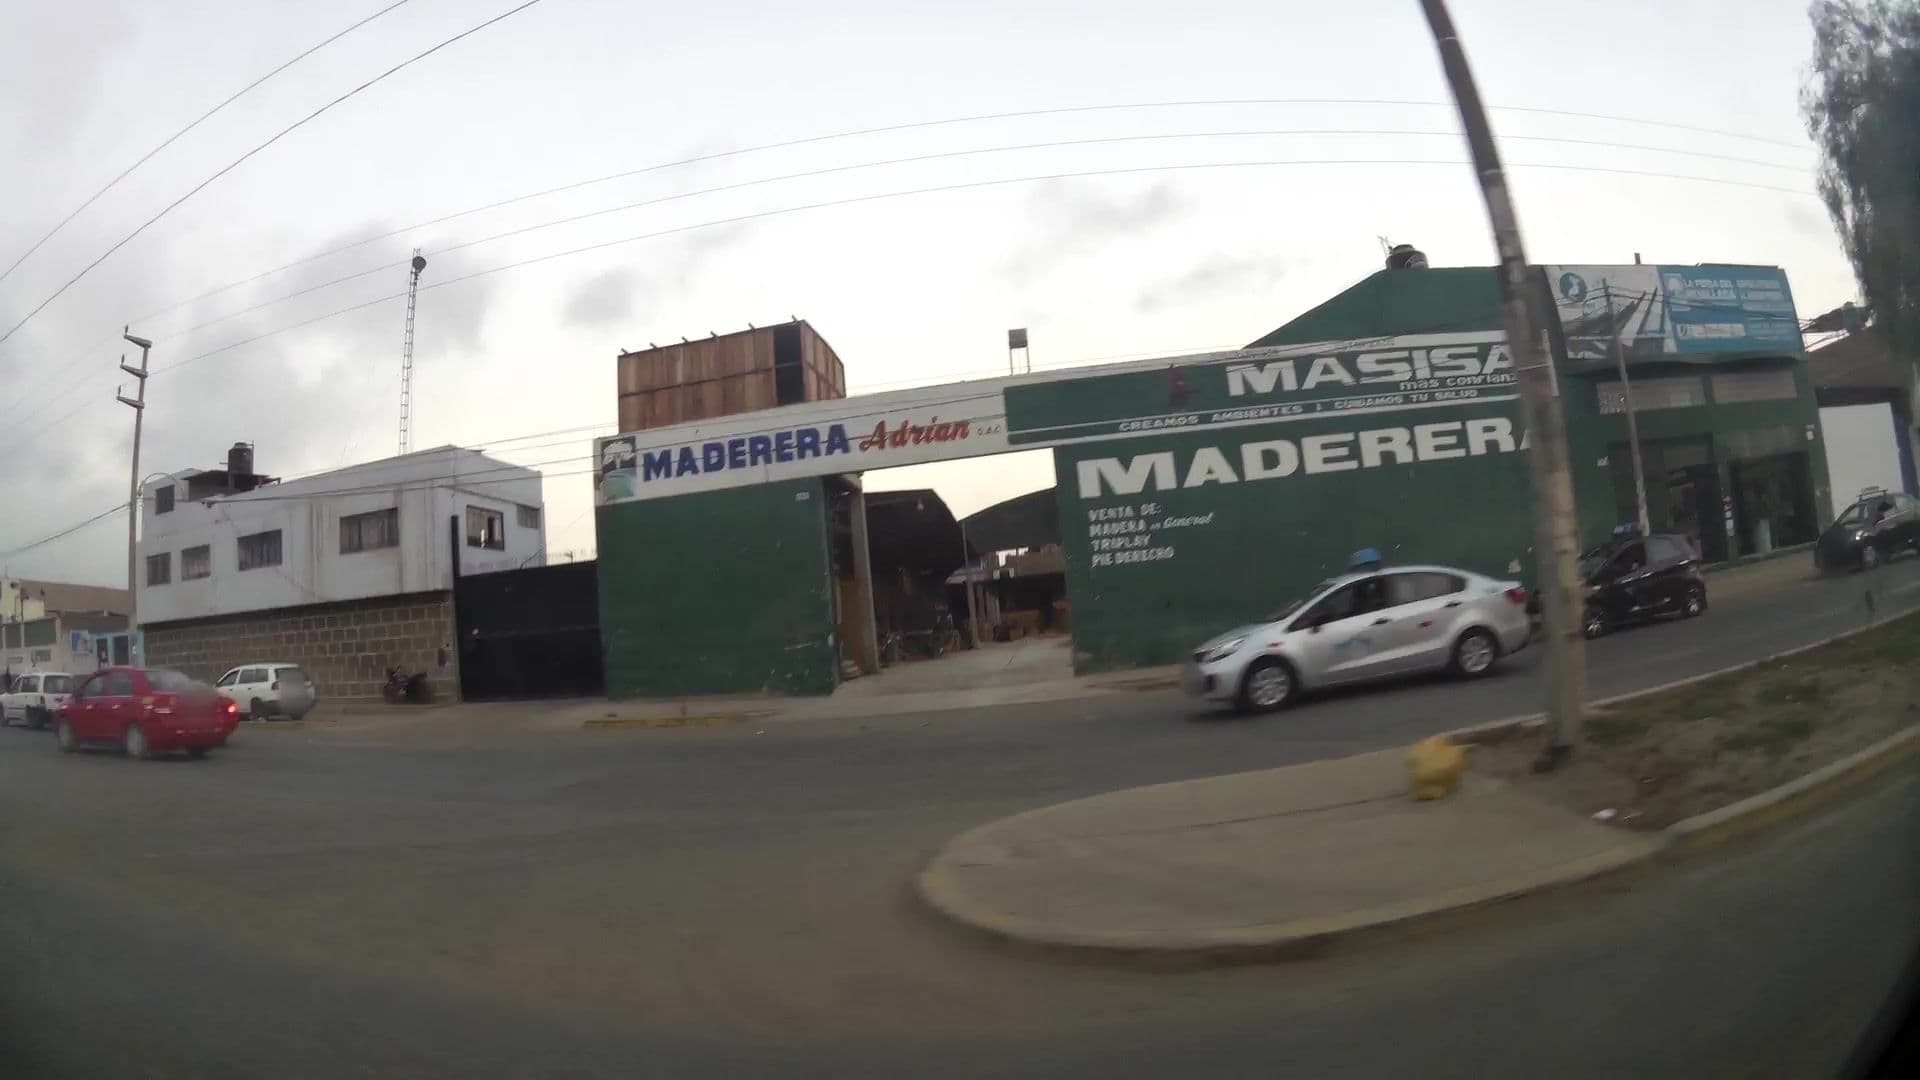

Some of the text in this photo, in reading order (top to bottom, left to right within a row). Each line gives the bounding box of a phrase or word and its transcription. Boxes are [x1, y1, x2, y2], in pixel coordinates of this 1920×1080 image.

[1225, 345, 1516, 396] MASISA
[1118, 415, 1200, 431] CREAMOS
[1210, 405, 1304, 422] AMBIENTES
[1333, 394, 1404, 410] CUDAMOS
[1409, 393, 1429, 402] TU
[1434, 389, 1478, 400] SALUD
[643, 424, 850, 482] MADERERA
[858, 416, 971, 452] Adrian
[1077, 417, 1532, 499] MADERER
[1088, 505, 1134, 522] VENTA
[1089, 519, 1147, 537] MADERA
[1162, 511, 1215, 529] General
[1091, 534, 1152, 551] TRIPLAY
[1091, 546, 1175, 568] PIE DERECHO
